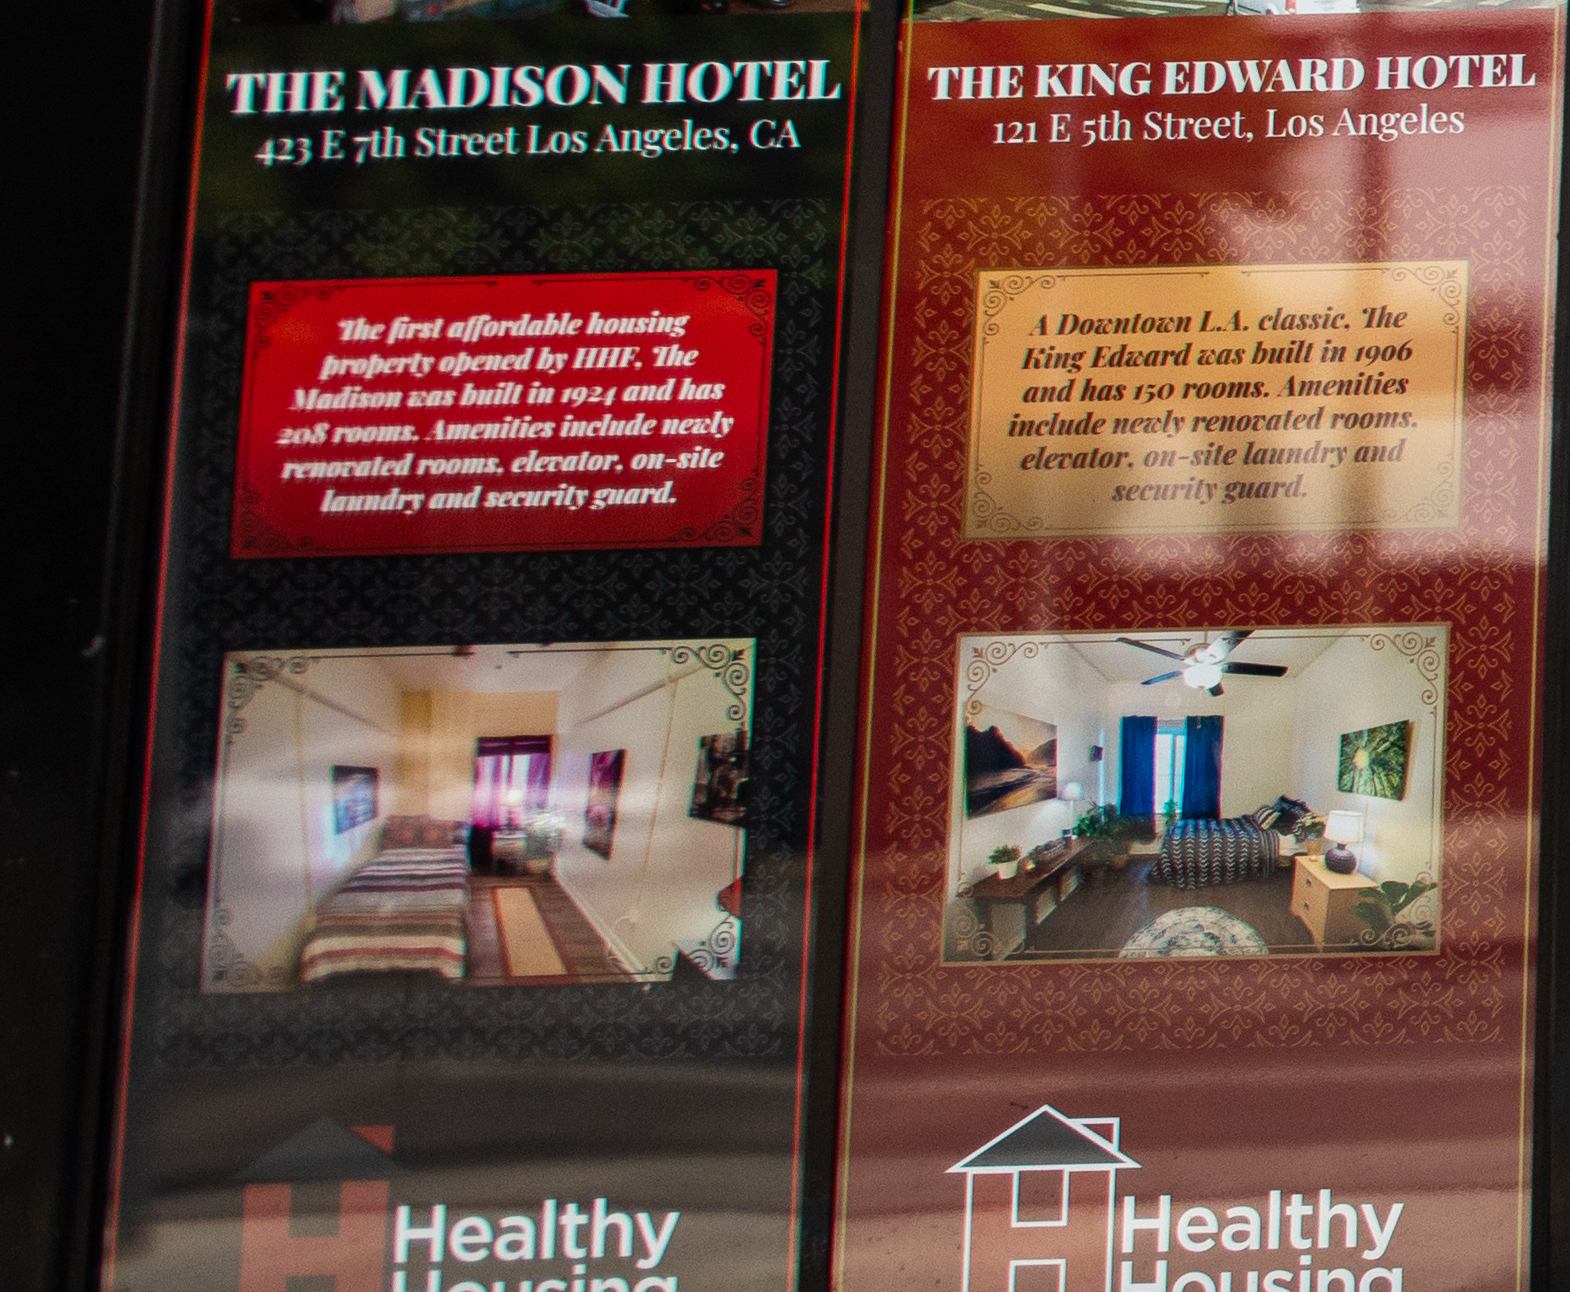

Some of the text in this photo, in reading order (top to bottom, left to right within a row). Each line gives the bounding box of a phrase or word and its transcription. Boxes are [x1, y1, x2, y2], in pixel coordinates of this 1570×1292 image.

[227, 59, 839, 115] THE MADISON HOTEL
[927, 53, 1536, 101] THE KING EDWARD HOTEL
[321, 129, 344, 161] E
[353, 125, 403, 164] 7th
[414, 126, 516, 158] Street
[526, 124, 586, 155] Los
[594, 118, 737, 159] Angeles,
[749, 118, 799, 150] CA
[993, 102, 1465, 147] 121 E 5th Street, Los Angeles
[338, 309, 691, 345] The first affordable housing
[1020, 338, 1413, 374] King Edward was built in 1906
[290, 377, 726, 411] Madison was built in 1924 and has
[394, 1197, 678, 1277] Healthy
[1120, 1188, 1404, 1266] Healthy
